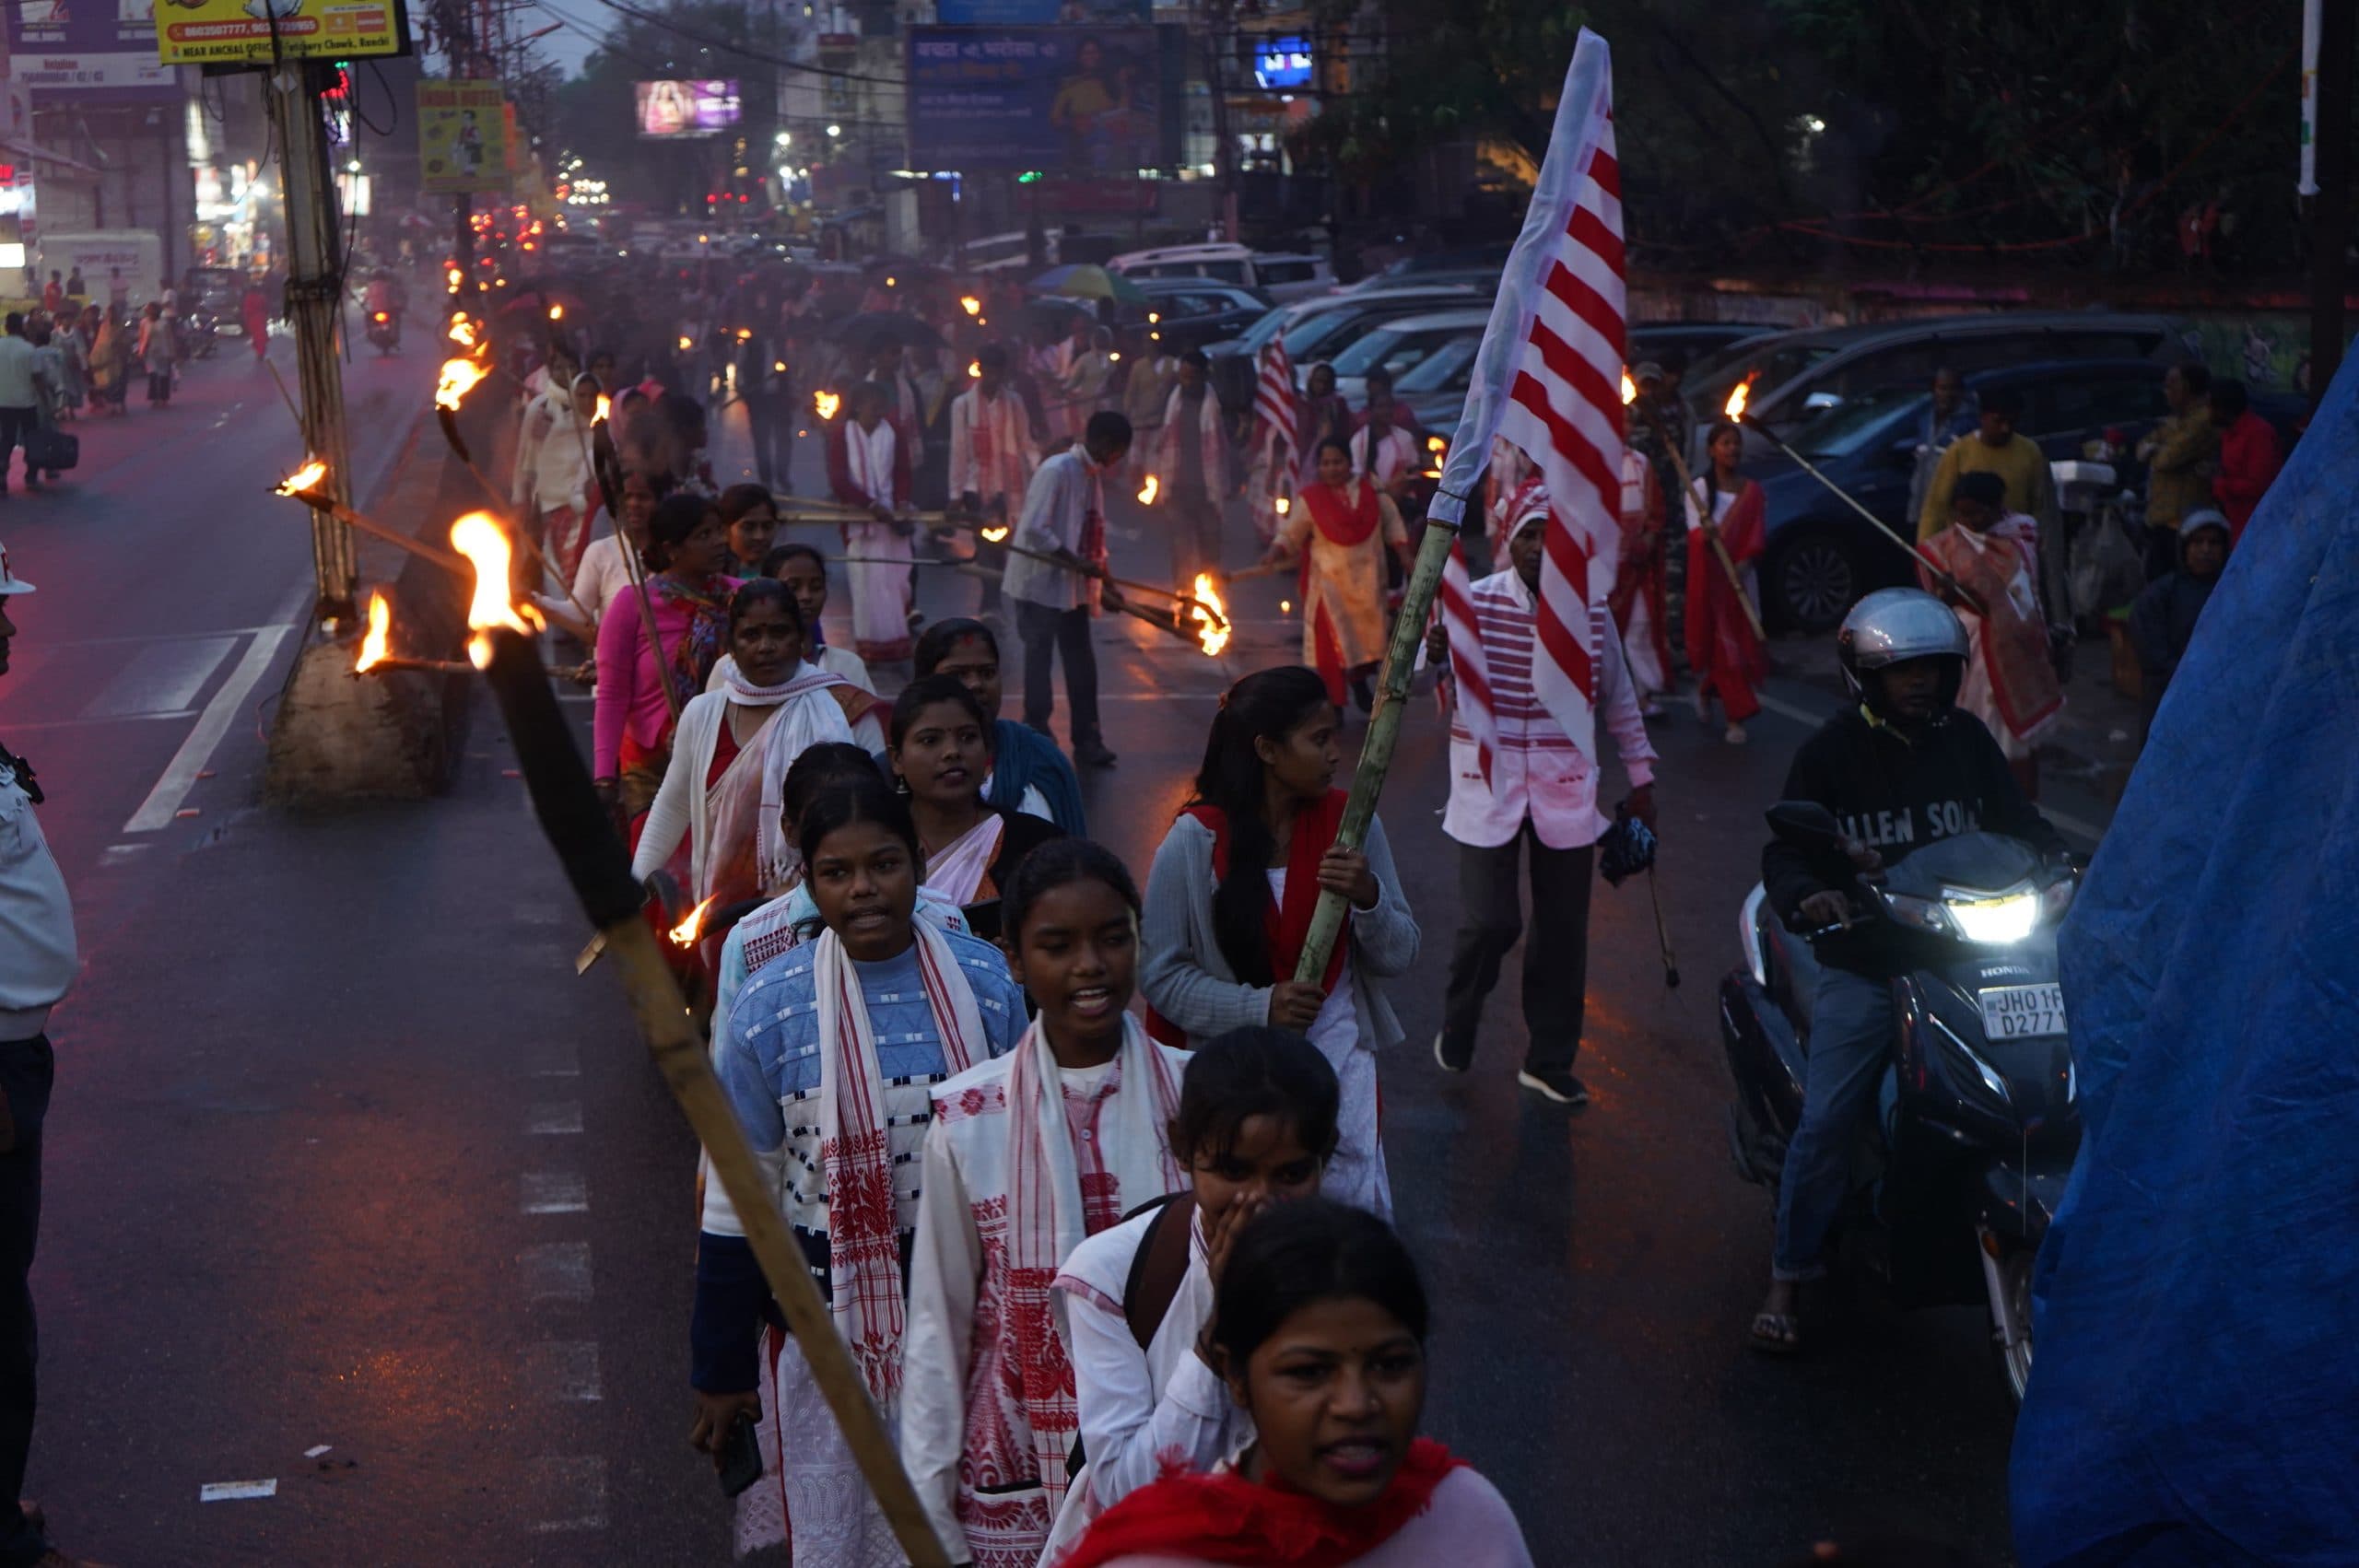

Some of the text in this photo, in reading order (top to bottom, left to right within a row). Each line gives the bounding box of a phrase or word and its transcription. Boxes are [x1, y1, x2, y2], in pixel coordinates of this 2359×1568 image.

[183, 45, 207, 56] NEAR
[209, 43, 243, 55] ANCHAL
[246, 41, 274, 53] OFFIC
[359, 36, 390, 47] Ranchi
[1980, 965, 2030, 977] HONDA
